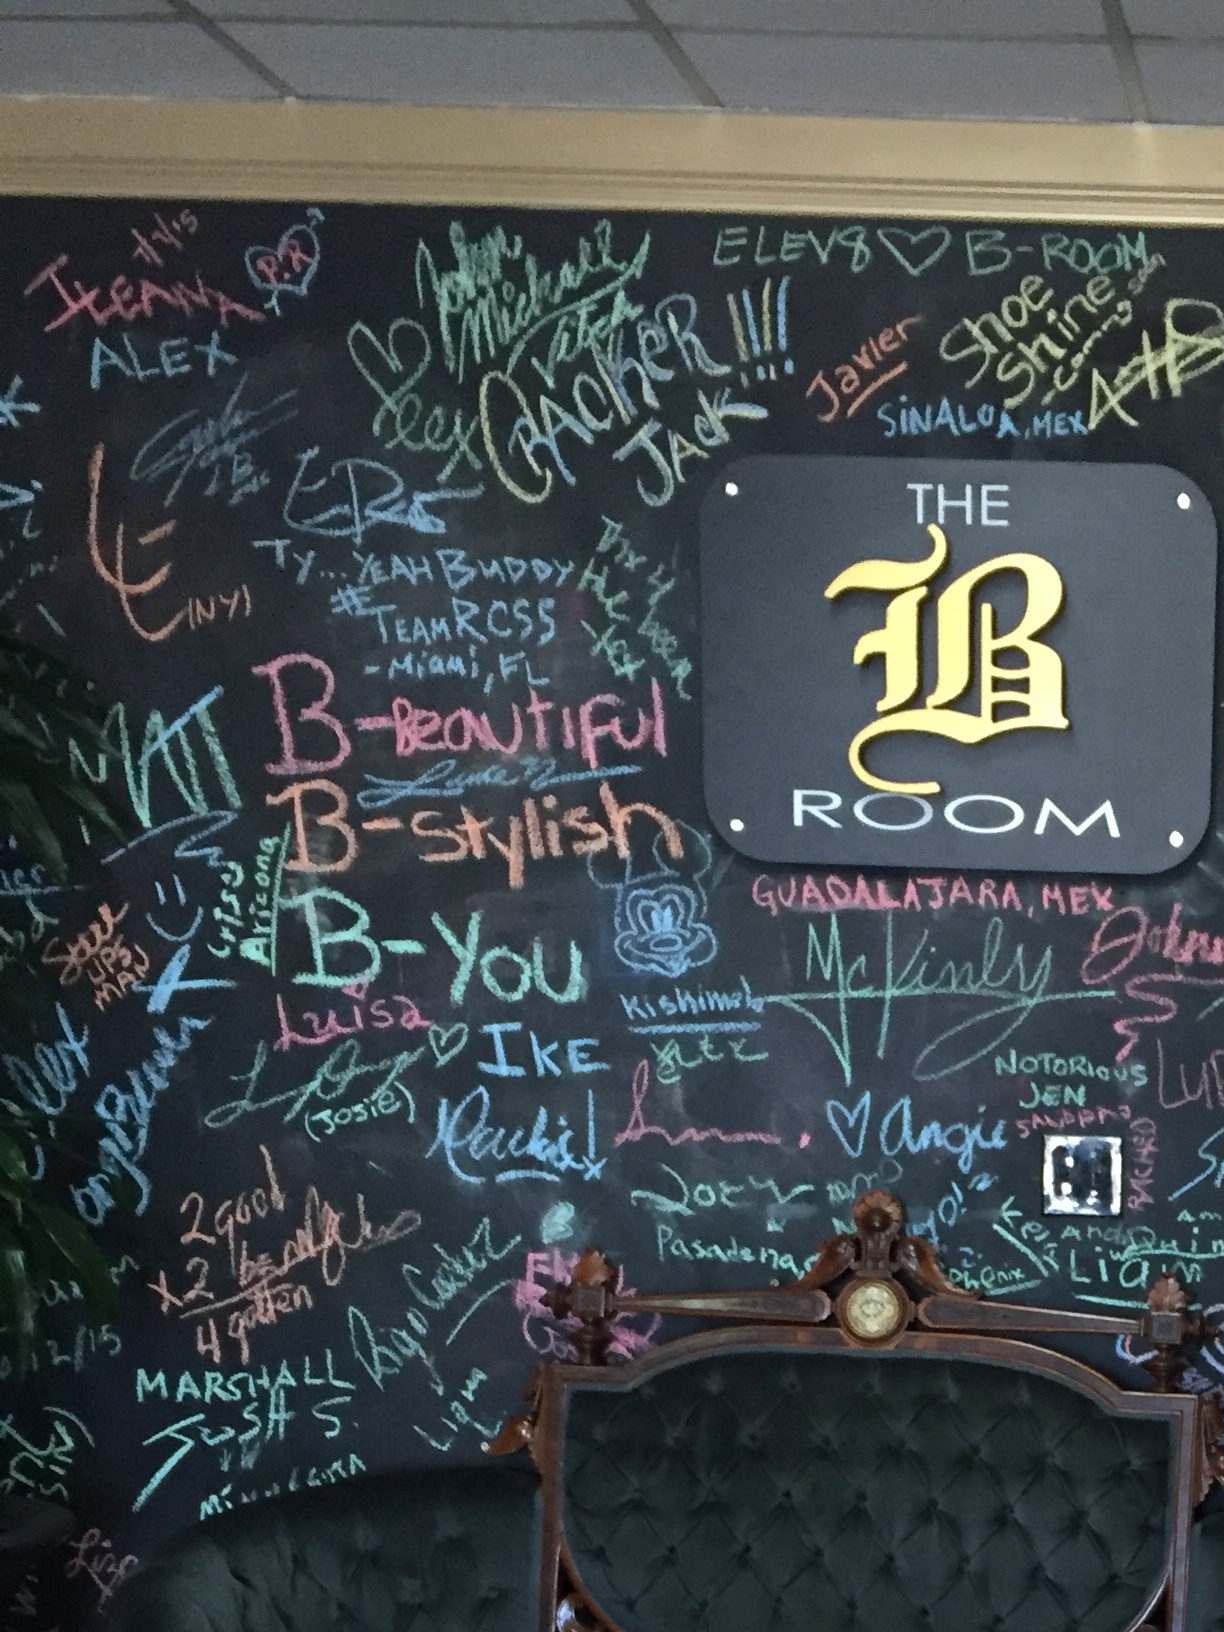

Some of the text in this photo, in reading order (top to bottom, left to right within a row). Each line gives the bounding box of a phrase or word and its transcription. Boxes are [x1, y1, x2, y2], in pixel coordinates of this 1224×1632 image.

[90, 330, 239, 390] ALEX
[907, 483, 1010, 526] THE
[824, 523, 1070, 795] B
[792, 788, 1121, 840] ROOM
[1041, 881, 1112, 916] MEX
[477, 1022, 611, 1077] IKE
[994, 1048, 1149, 1088] NOTORIOUS
[1018, 1080, 1087, 1109] JEN
[136, 1348, 357, 1405] MARSHALL
